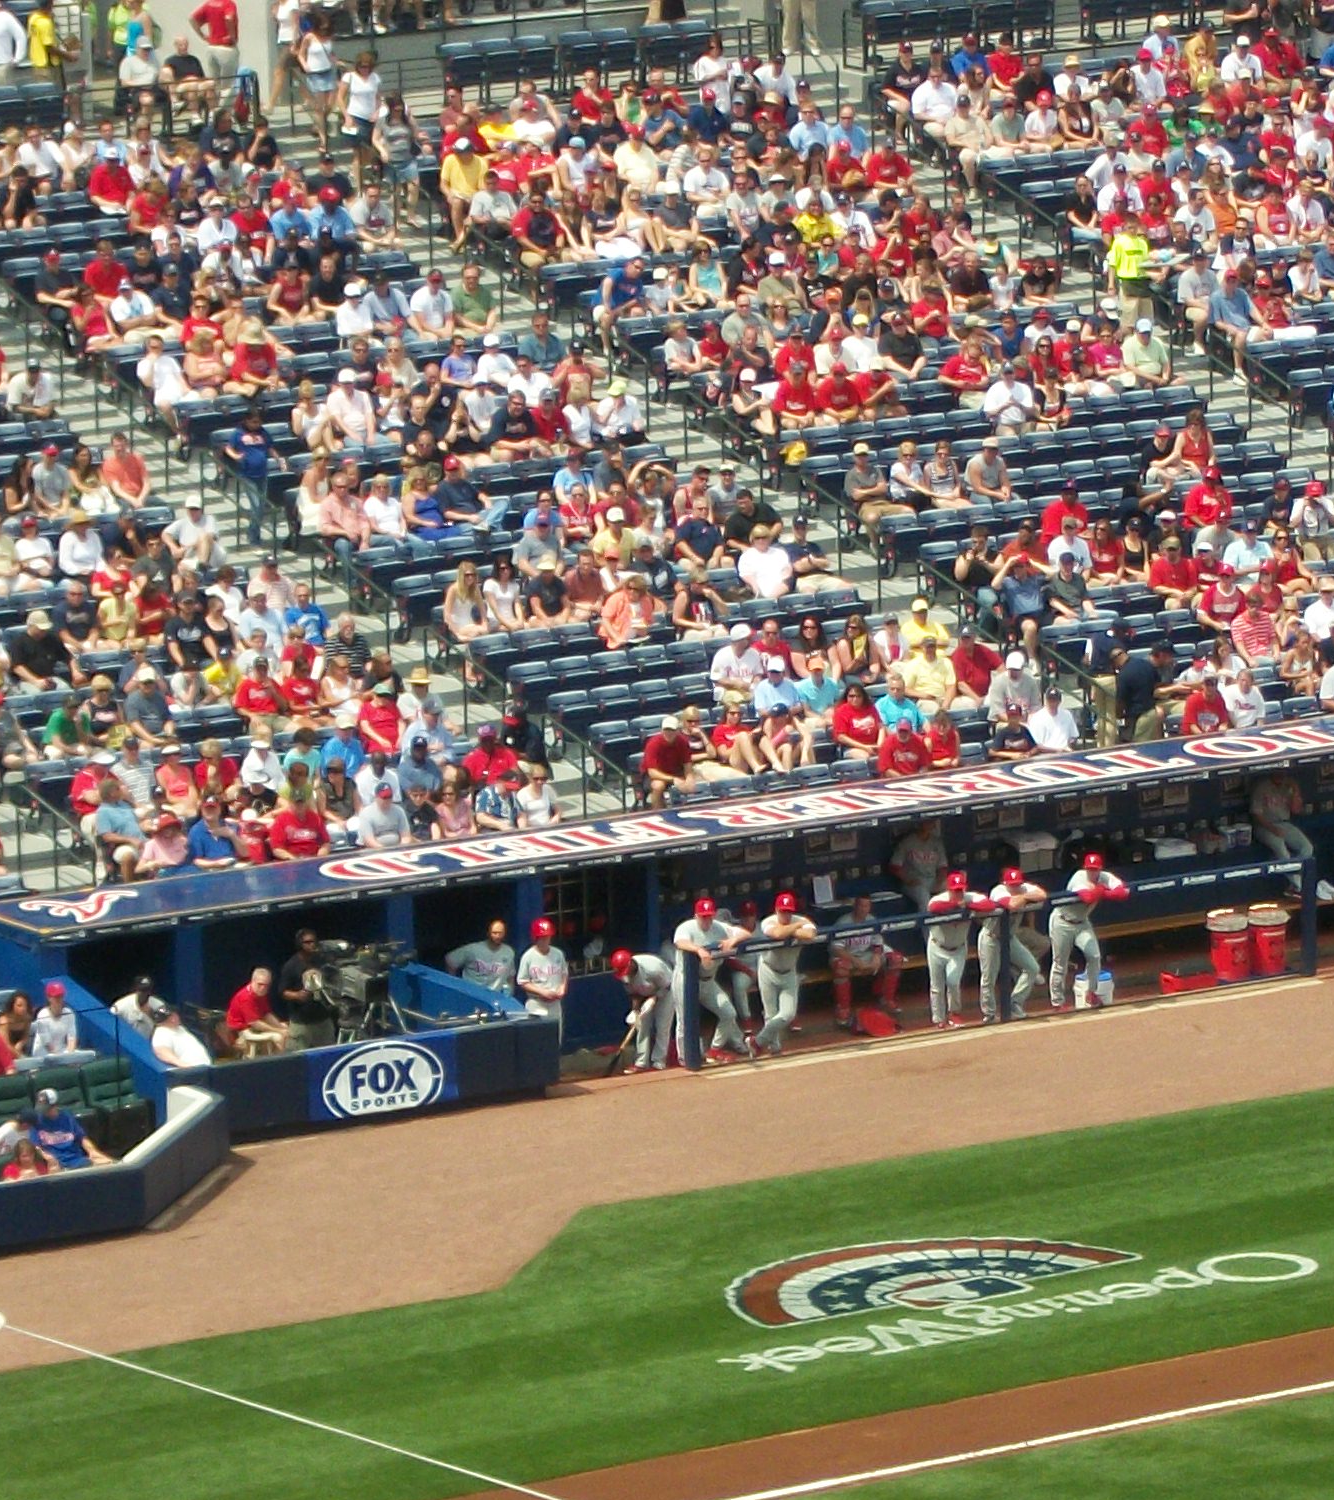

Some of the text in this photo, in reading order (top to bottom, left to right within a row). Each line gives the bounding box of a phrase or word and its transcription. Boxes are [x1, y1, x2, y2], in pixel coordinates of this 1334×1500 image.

[677, 749, 1197, 829] TURNER
[319, 816, 707, 880] FIELD
[349, 1056, 416, 1099] FOX
[350, 1092, 419, 1112] SPORTS
[717, 1252, 1318, 1373] Opening Week
